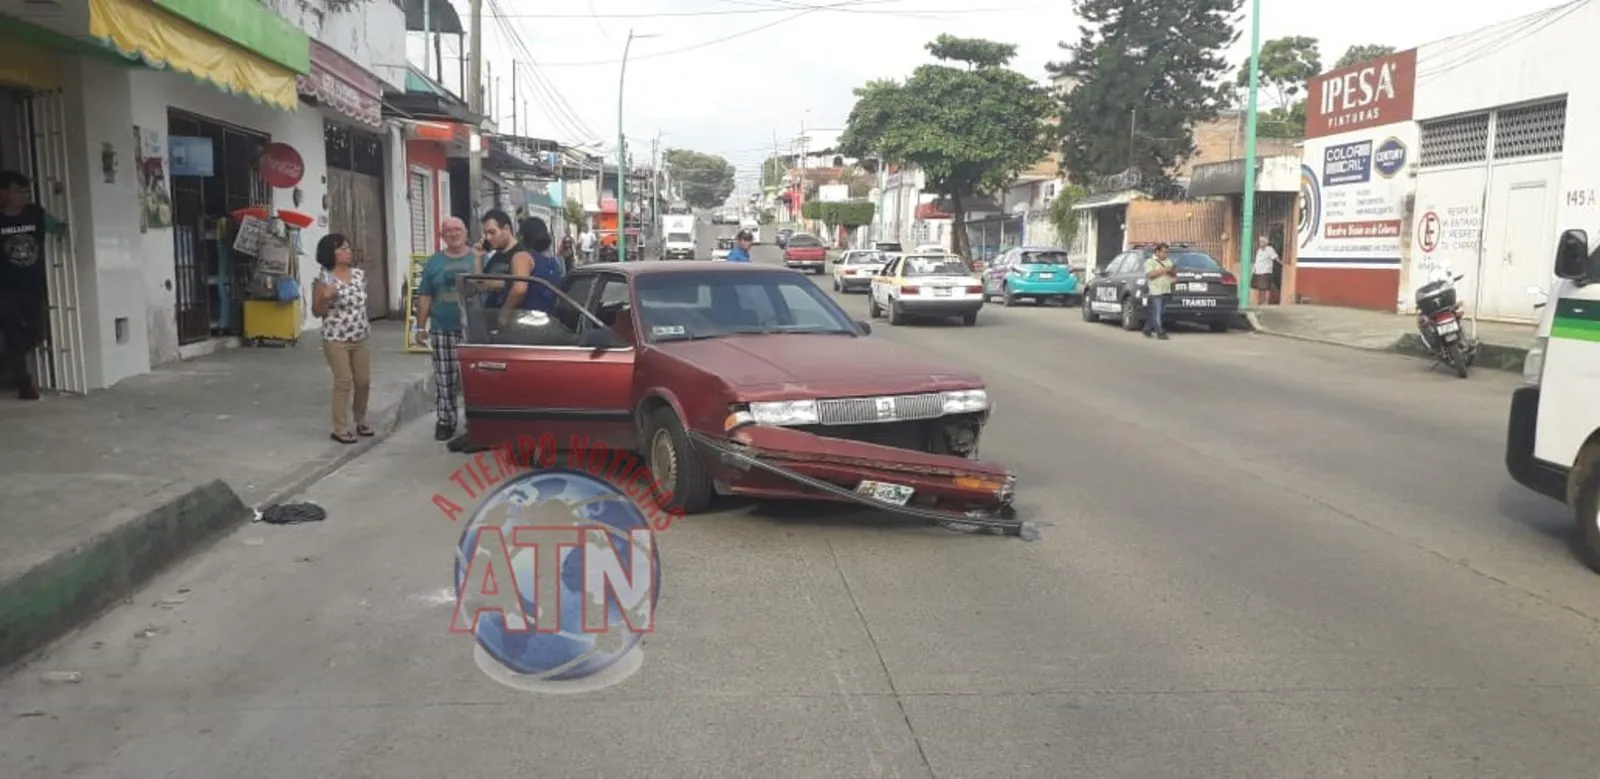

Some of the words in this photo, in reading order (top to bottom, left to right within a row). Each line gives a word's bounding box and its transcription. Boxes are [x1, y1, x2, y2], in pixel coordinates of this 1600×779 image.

[1321, 62, 1395, 114] IPESA
[1328, 107, 1379, 129] PINTURAS
[1327, 145, 1360, 161] COLOR
